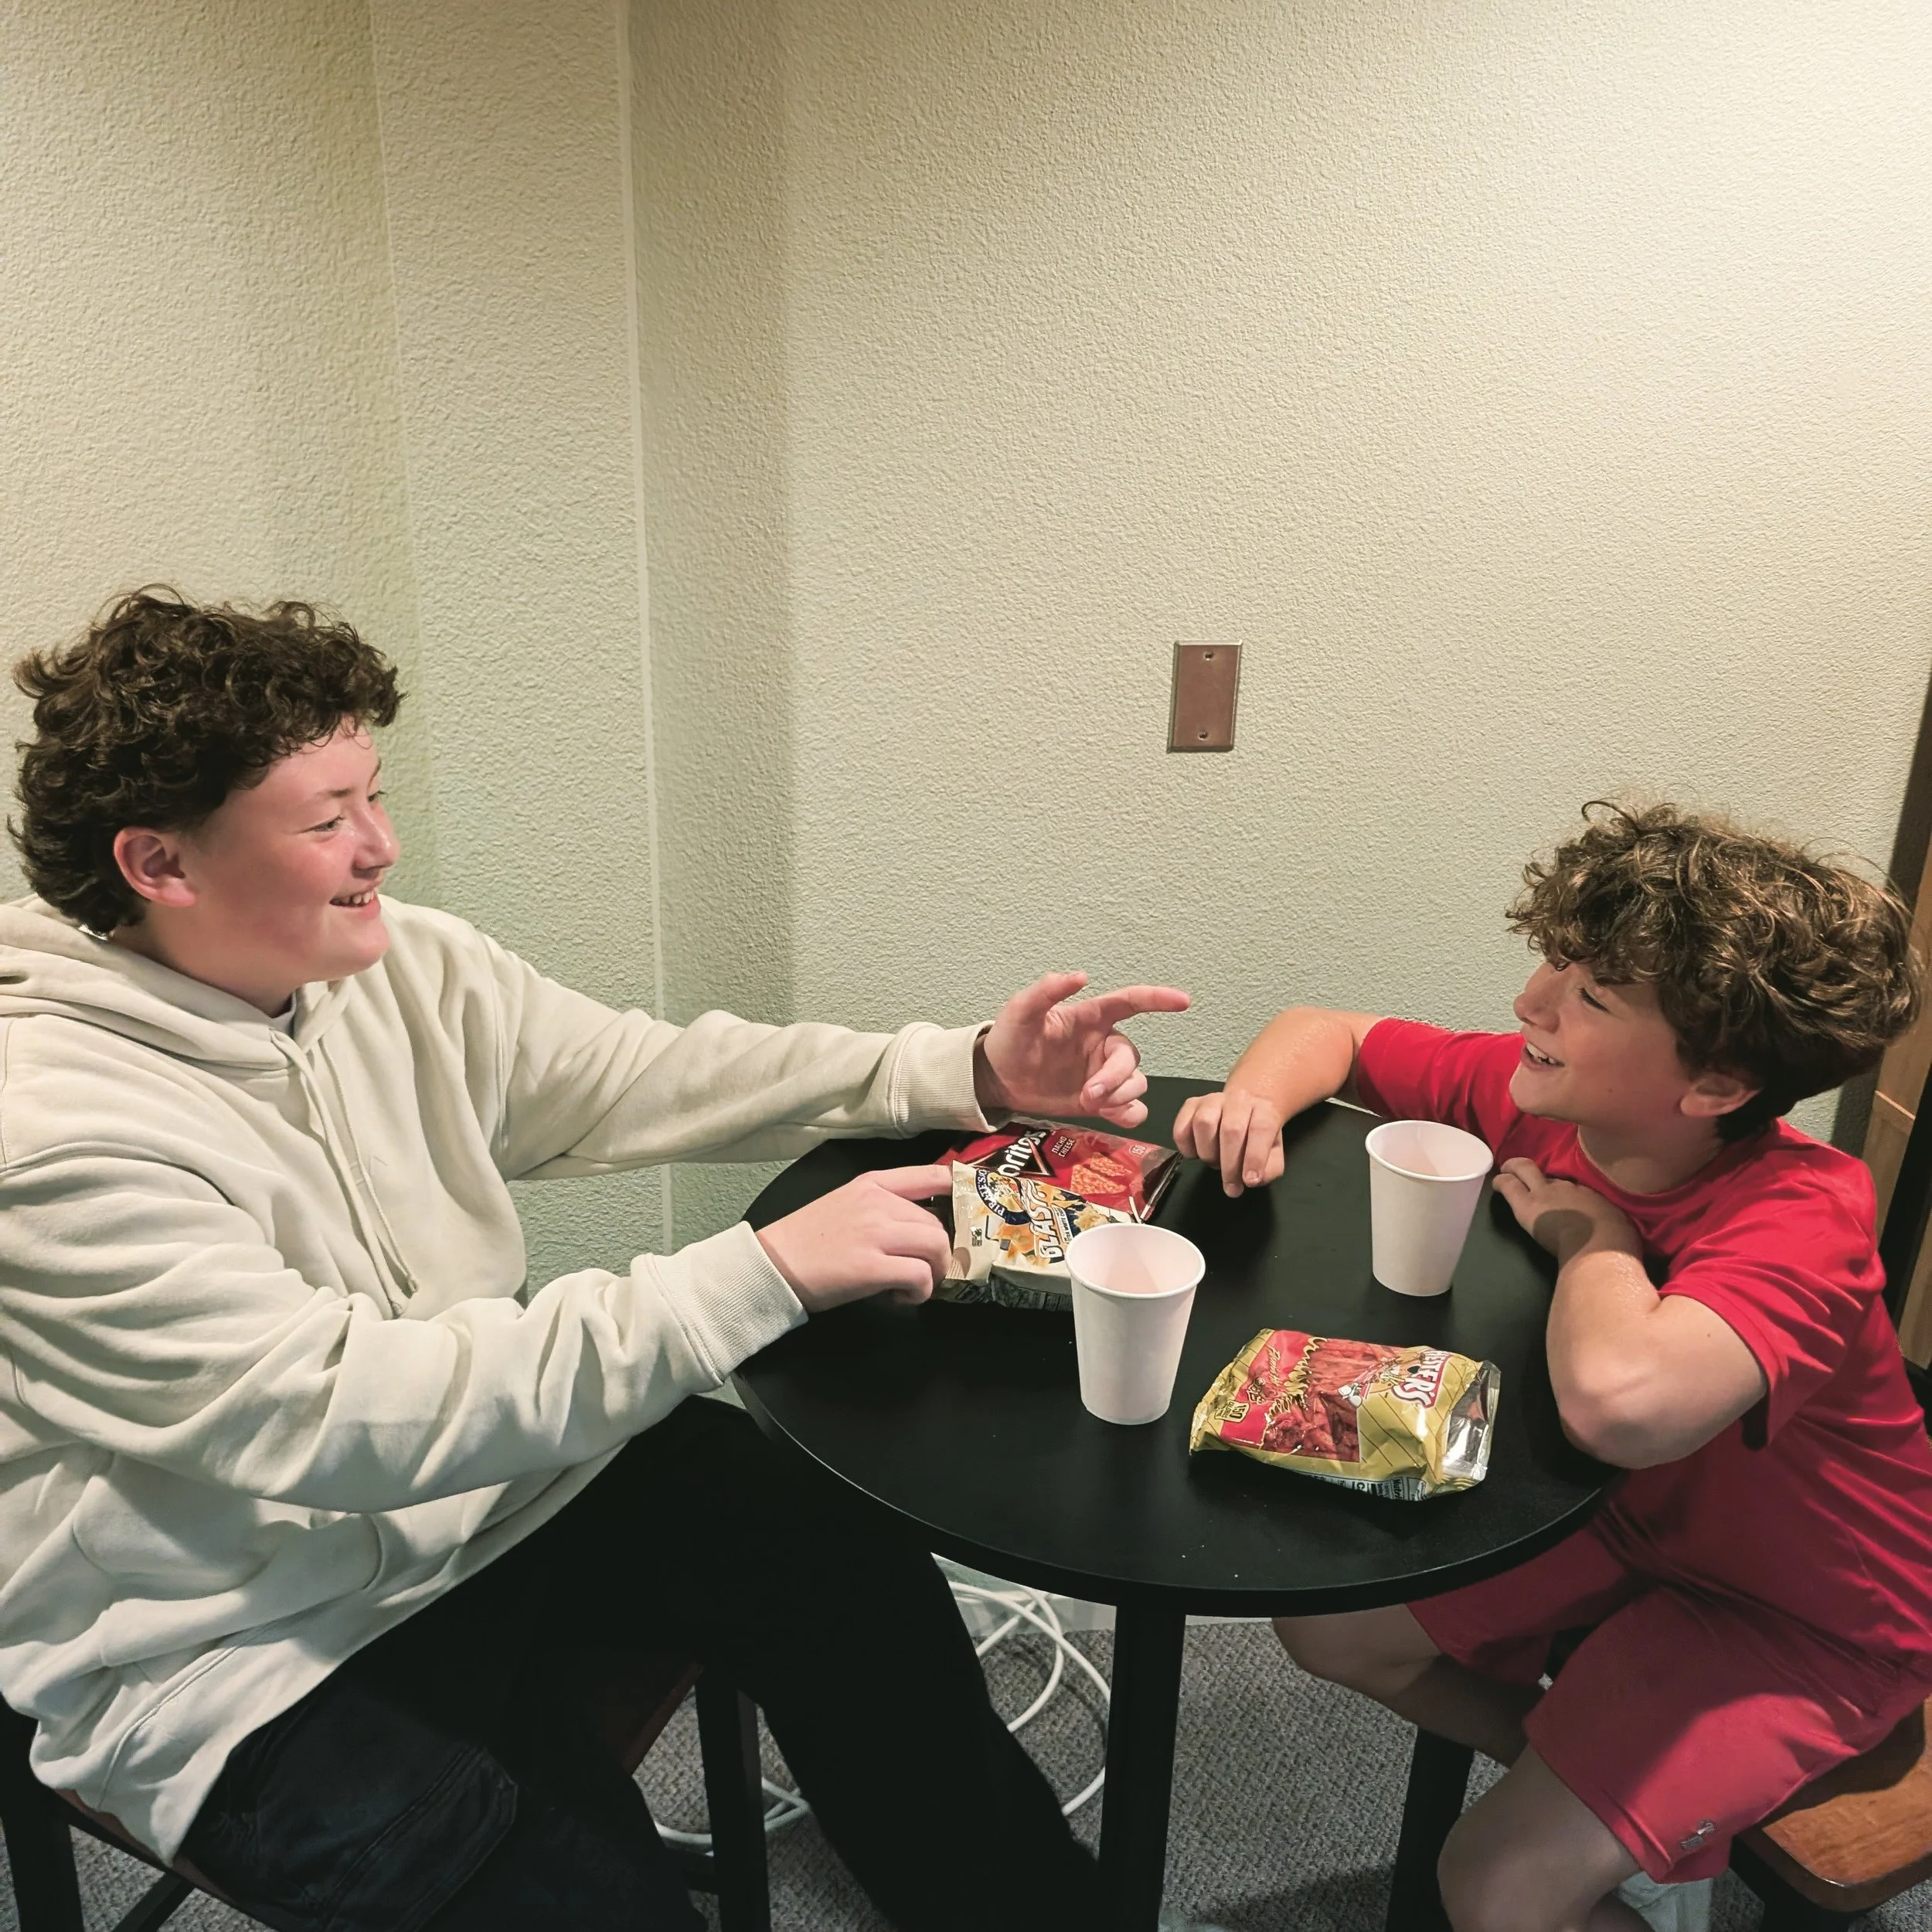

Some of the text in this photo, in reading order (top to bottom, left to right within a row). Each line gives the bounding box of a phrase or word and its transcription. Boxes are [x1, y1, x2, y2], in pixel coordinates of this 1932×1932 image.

[998, 1130, 1048, 1176] oritos
[1051, 1136, 1067, 1153] NACHO
[1058, 1138, 1075, 1157] CHEESE
[1393, 1351, 1449, 1406] HESTER'S
[1230, 1405, 1246, 1419] 150
